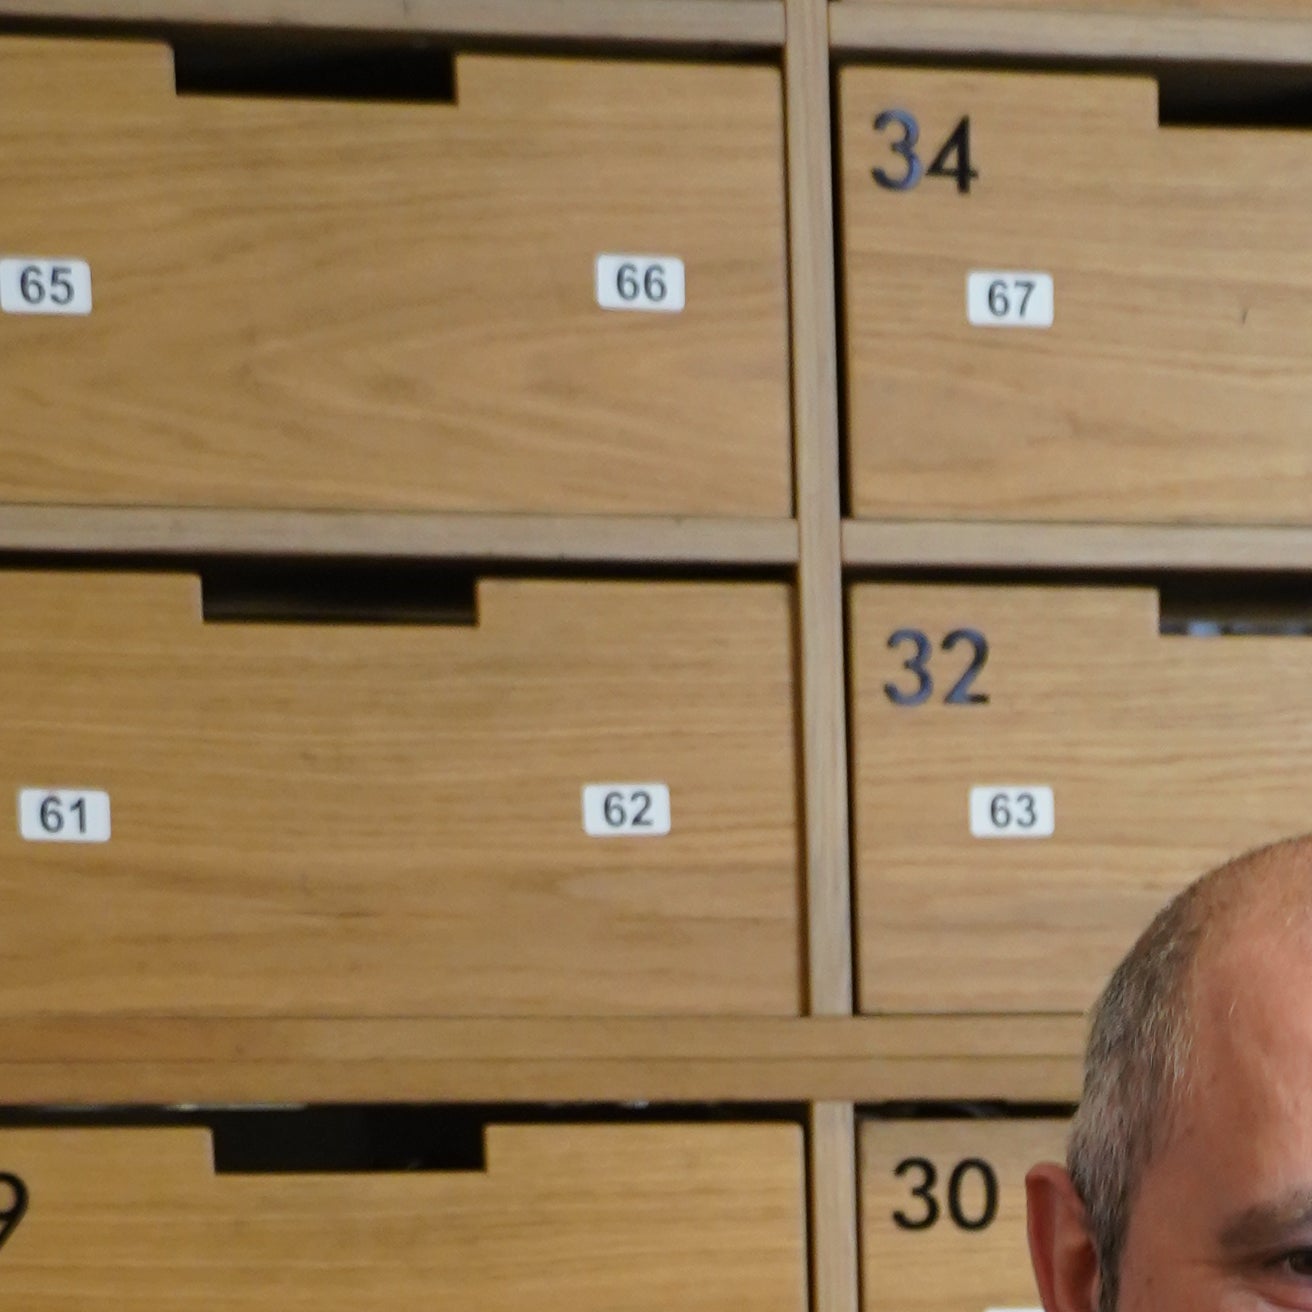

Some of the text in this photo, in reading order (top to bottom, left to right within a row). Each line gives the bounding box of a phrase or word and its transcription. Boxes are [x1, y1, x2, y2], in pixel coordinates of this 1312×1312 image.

[872, 110, 979, 195] 34
[18, 265, 75, 305] 65
[615, 263, 668, 302] 66
[986, 279, 1036, 317] 67
[883, 628, 990, 707] 32
[39, 795, 89, 834] 61
[602, 790, 654, 828] 62
[989, 792, 1038, 829] 63
[892, 1156, 1000, 1233] 30
